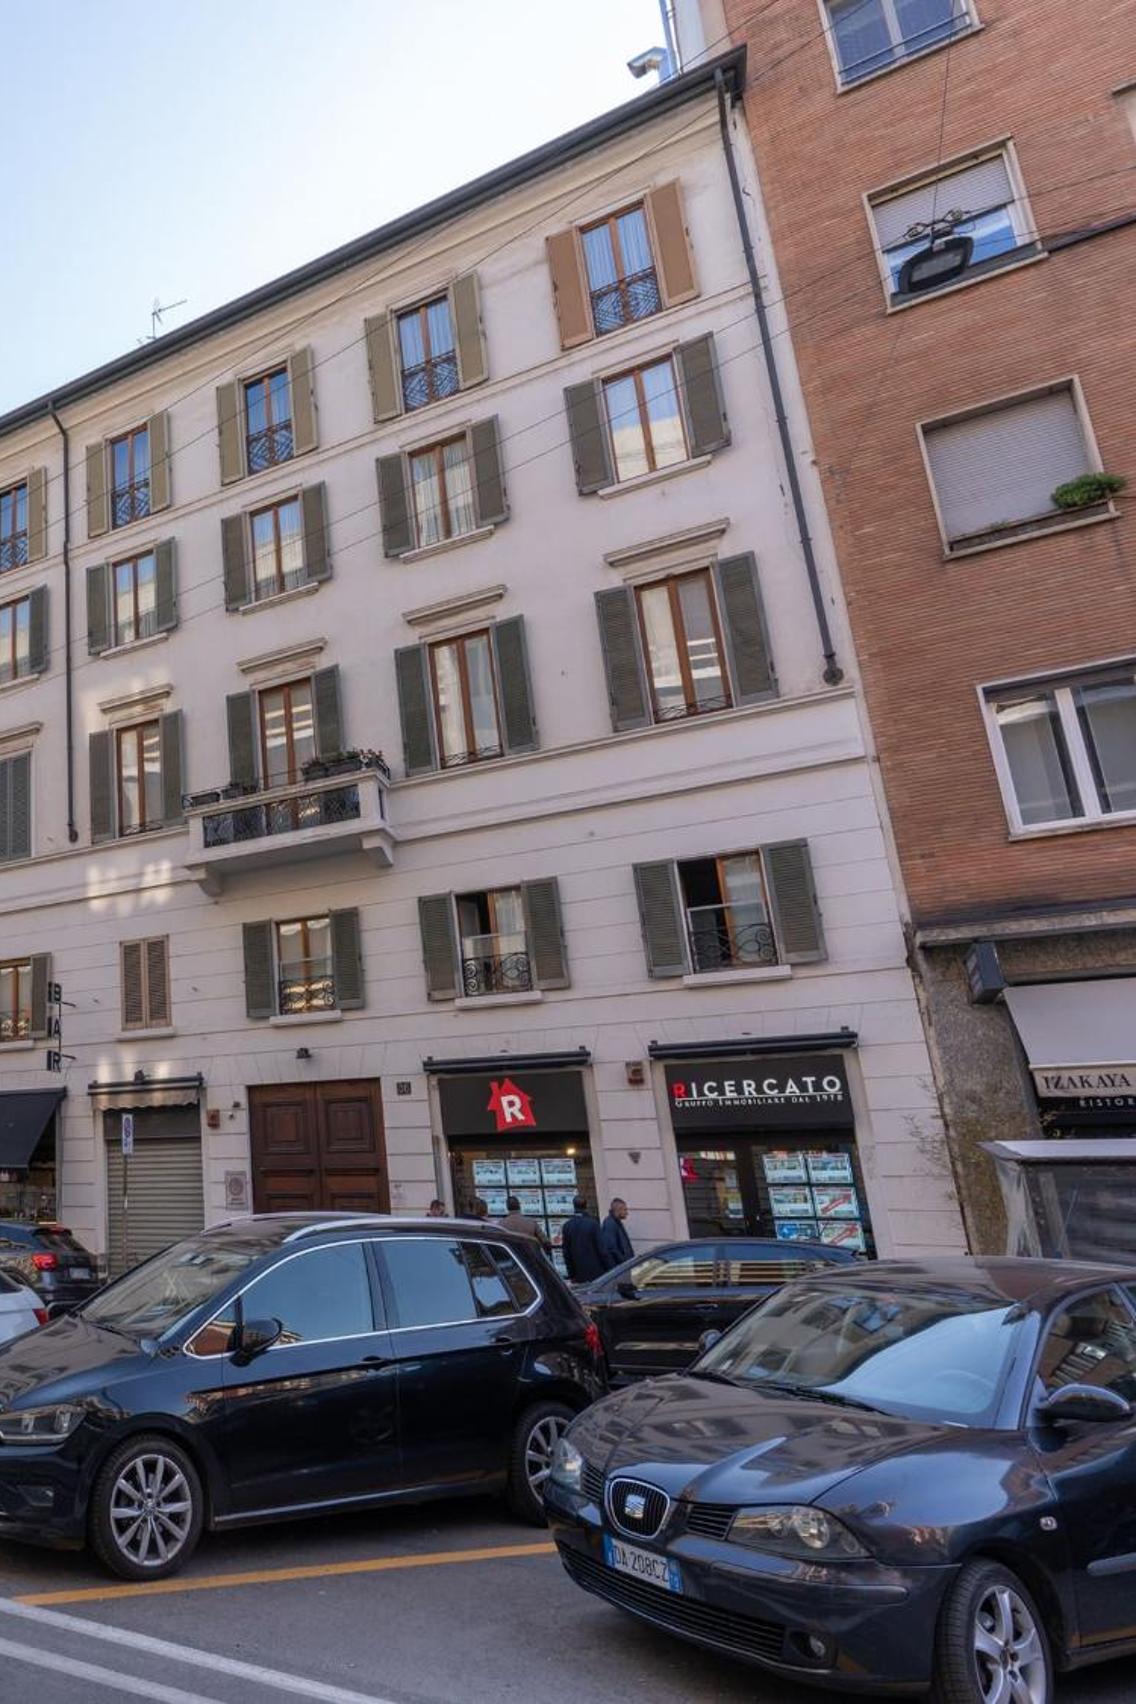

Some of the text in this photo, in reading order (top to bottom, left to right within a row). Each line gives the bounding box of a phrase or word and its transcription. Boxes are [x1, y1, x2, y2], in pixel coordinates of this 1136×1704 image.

[672, 1075, 842, 1098] RICERCATO
[1041, 1073, 1131, 1090] IZAKAYA
[499, 1095, 526, 1124] R
